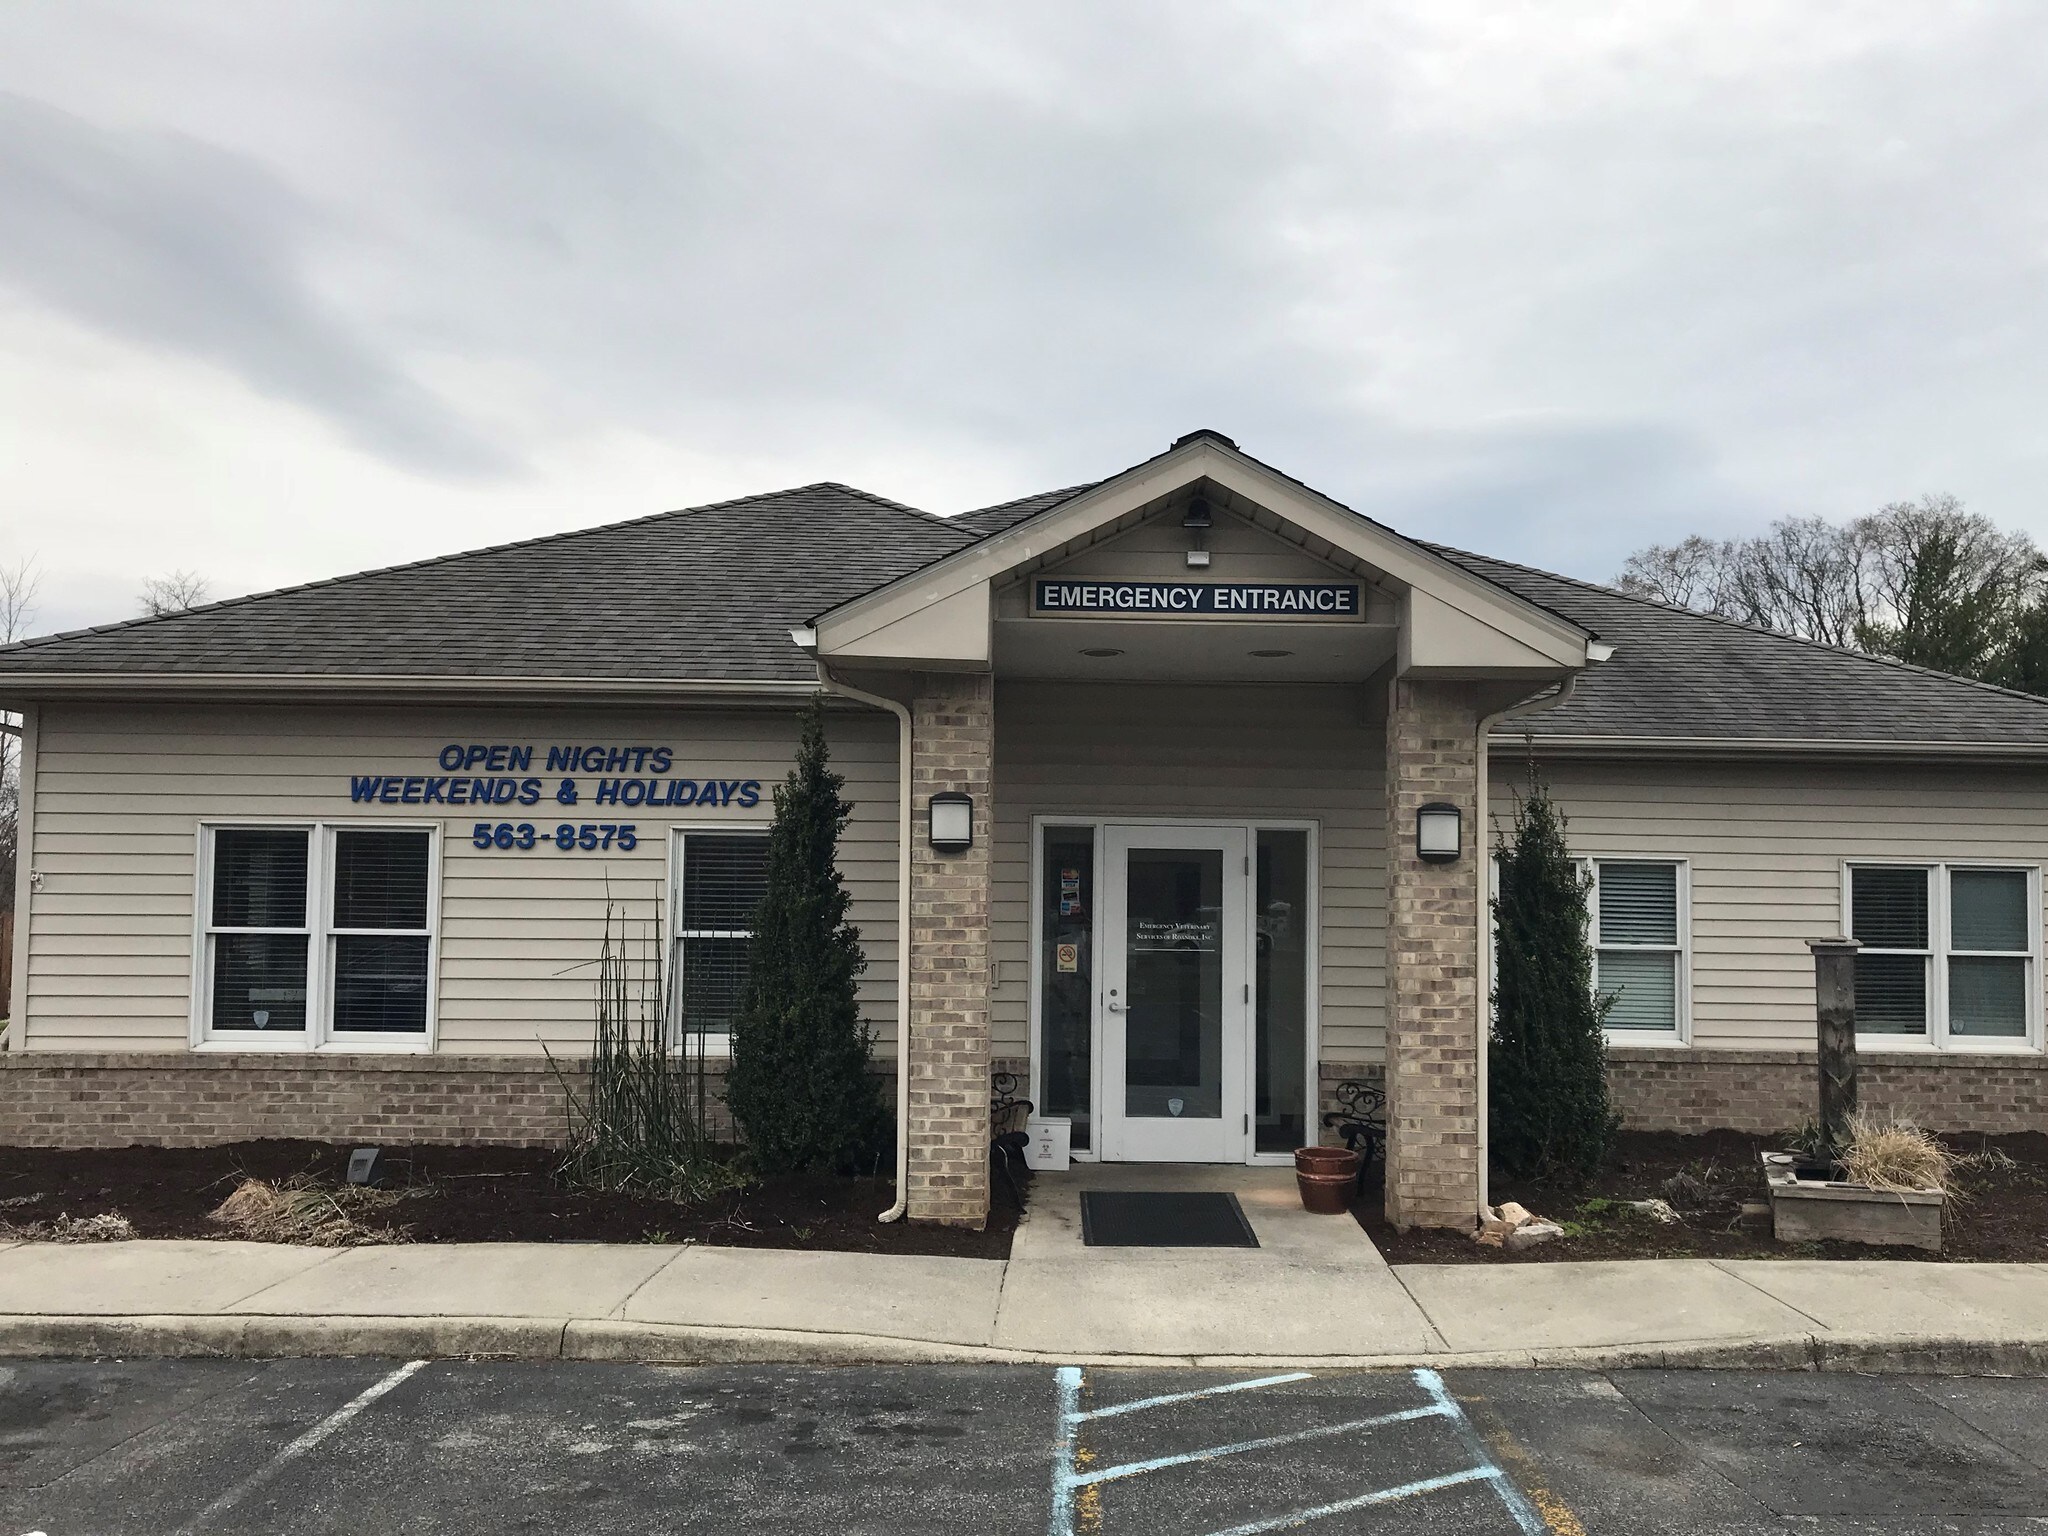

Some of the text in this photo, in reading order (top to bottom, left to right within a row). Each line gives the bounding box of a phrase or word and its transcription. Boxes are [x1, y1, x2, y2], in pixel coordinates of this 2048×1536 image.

[1044, 585, 1351, 611] EMERGENCY ENTRANCE
[438, 744, 674, 773] OPEN NIGHTS
[350, 776, 761, 808] WEEKENDS & HOLIDAYS
[472, 823, 638, 851] 563-8575
